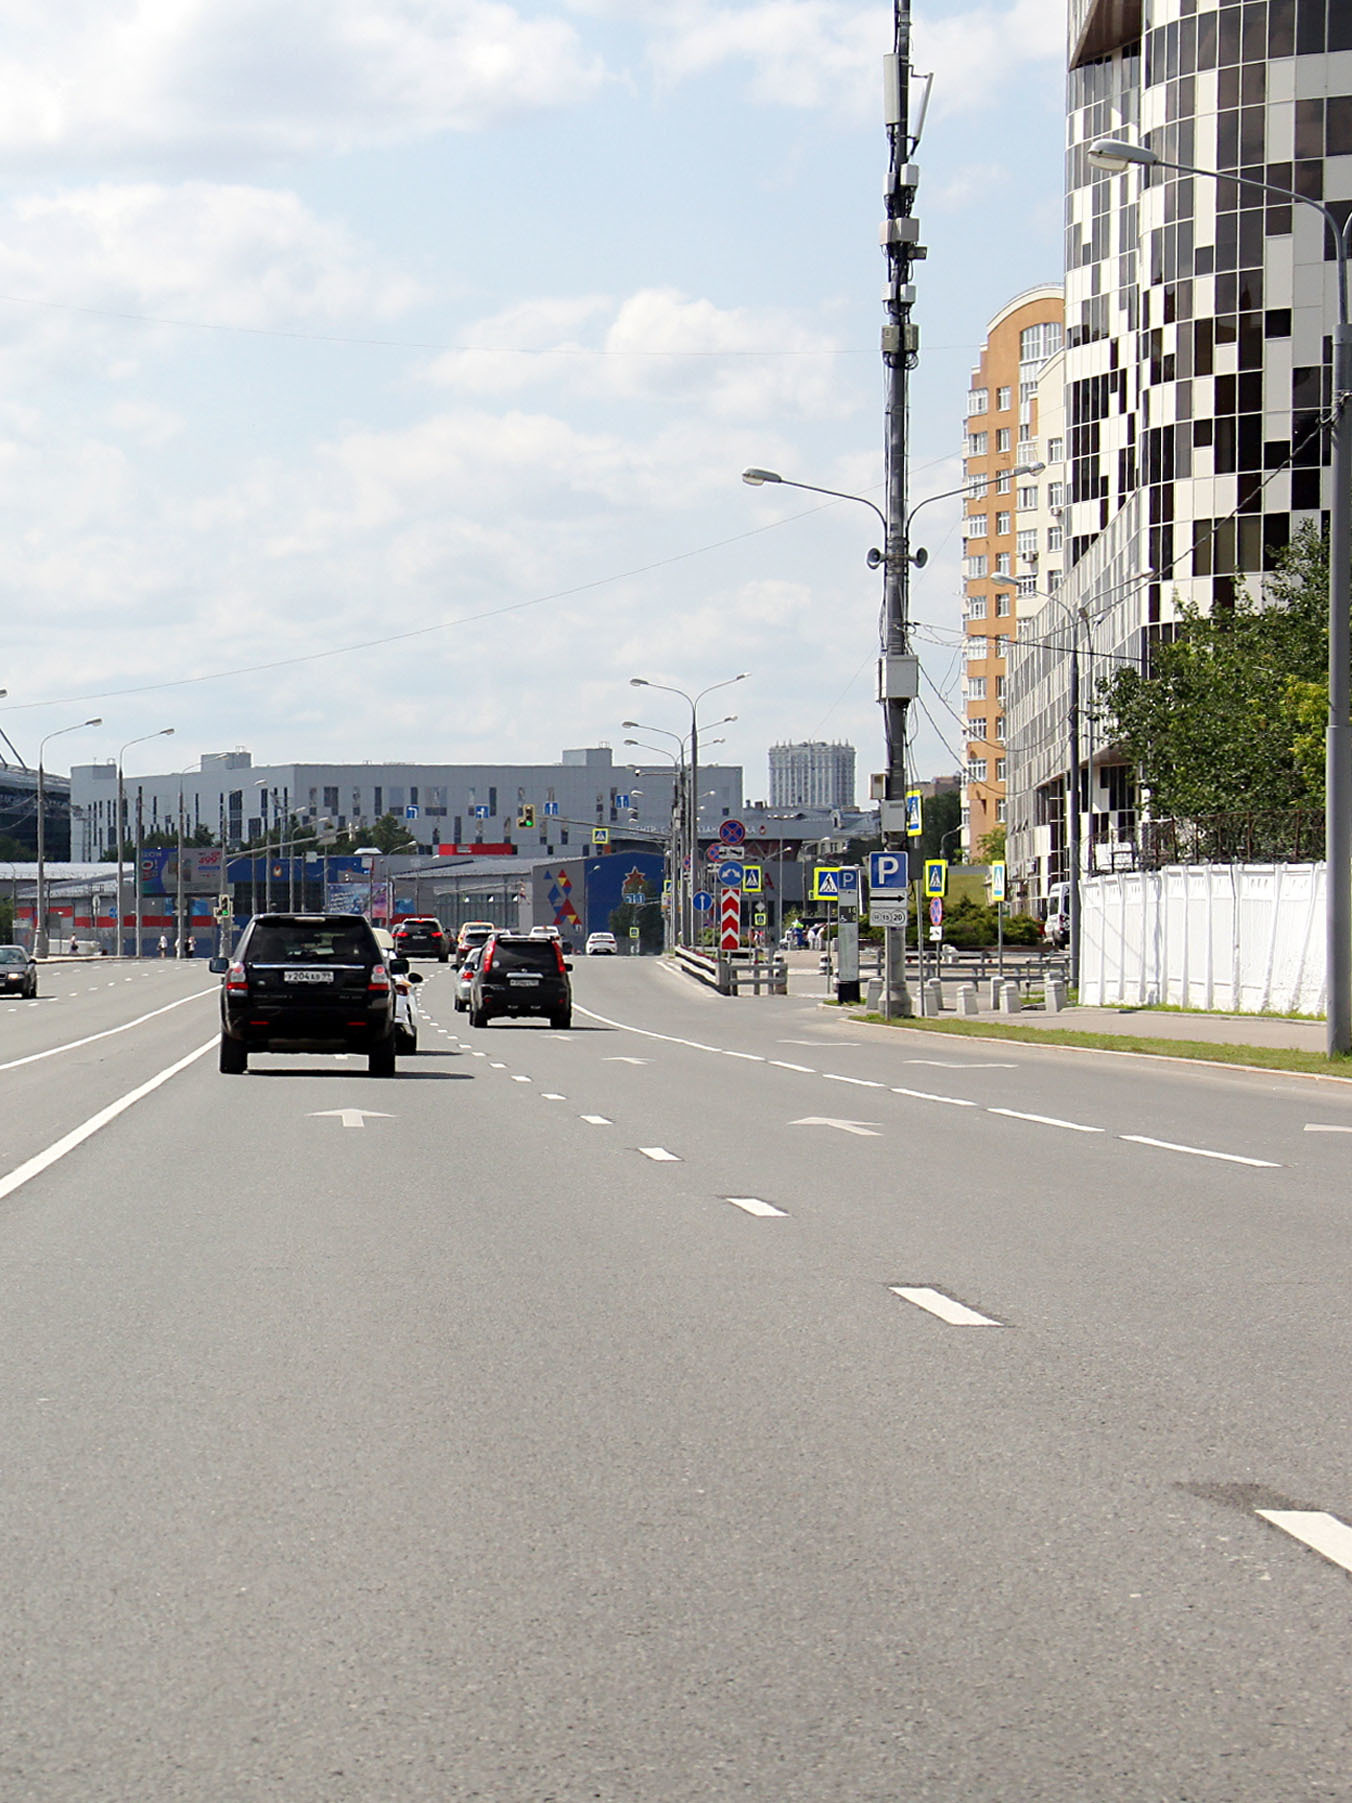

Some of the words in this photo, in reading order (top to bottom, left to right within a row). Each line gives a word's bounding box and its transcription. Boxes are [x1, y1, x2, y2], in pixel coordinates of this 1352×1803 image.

[878, 856, 899, 885] P
[843, 872, 854, 888] P
[893, 913, 903, 921] 20
